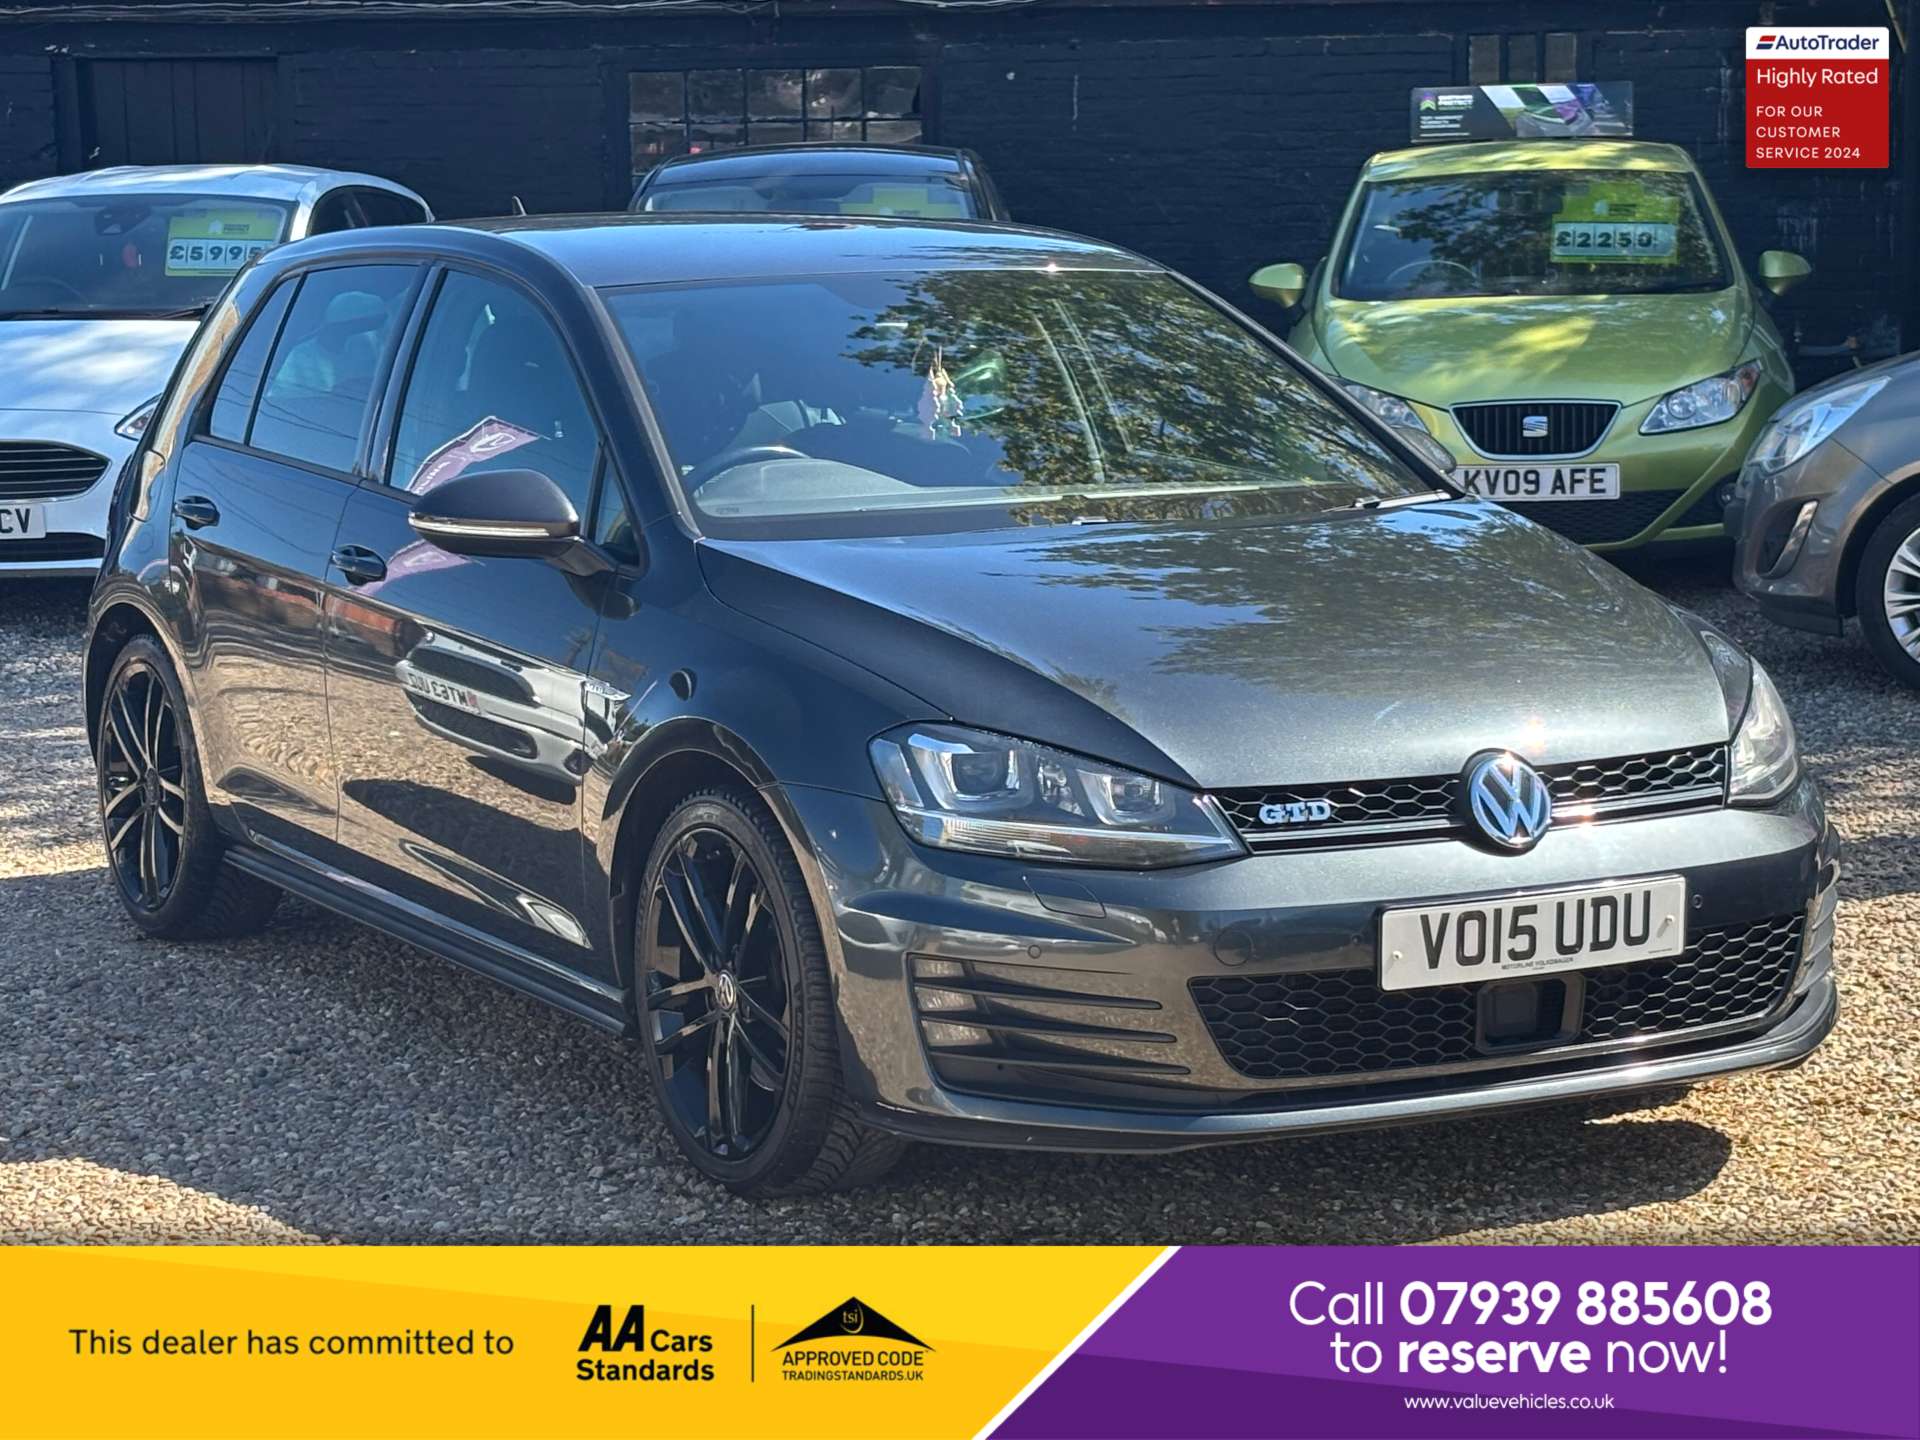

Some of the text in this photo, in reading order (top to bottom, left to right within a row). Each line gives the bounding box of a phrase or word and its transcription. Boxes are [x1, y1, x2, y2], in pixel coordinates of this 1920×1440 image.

[1463, 468, 1606, 495] KV09 AFE
[1259, 800, 1331, 824] GTD
[1420, 890, 1651, 969] VO15 UDU
